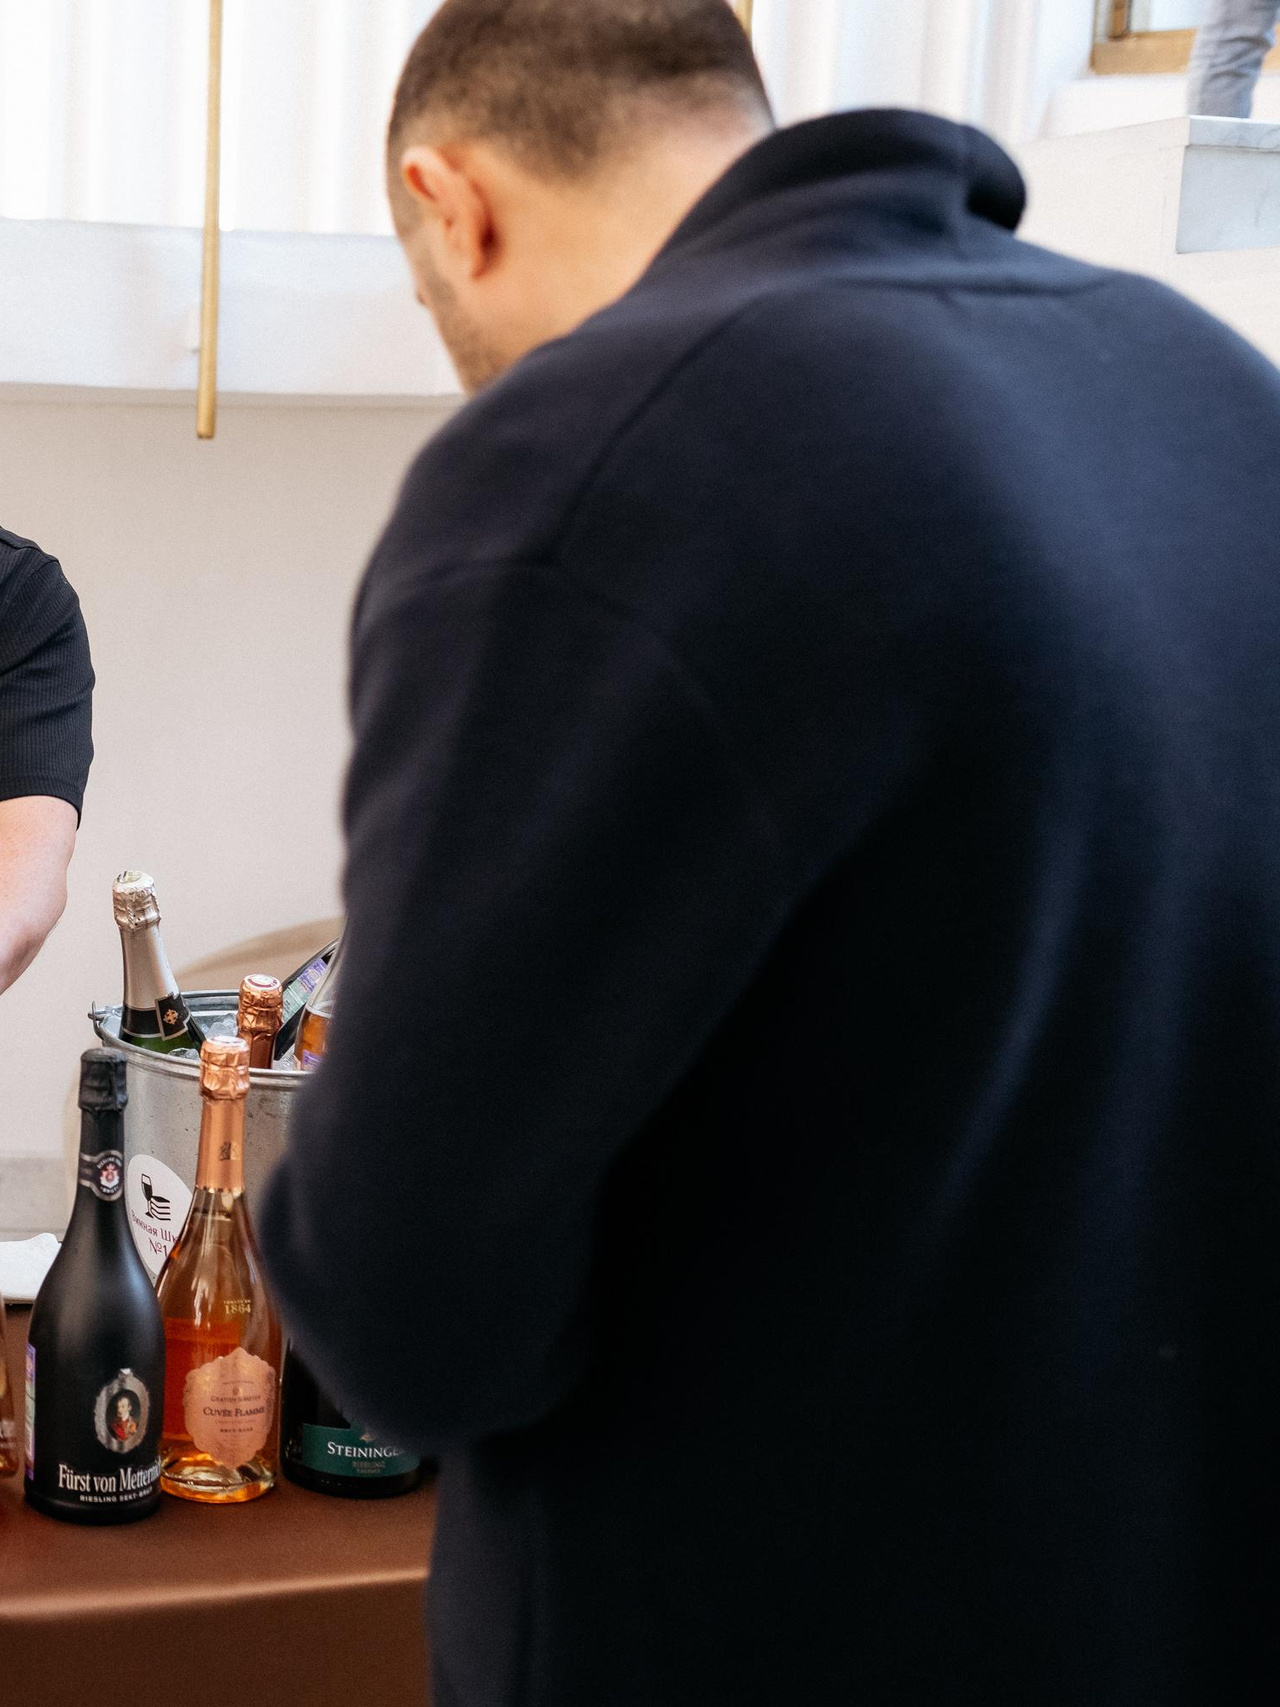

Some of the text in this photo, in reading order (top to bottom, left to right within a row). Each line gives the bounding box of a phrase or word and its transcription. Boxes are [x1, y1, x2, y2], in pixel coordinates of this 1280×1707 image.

[58, 1462, 92, 1493] Fürst
[92, 1475, 117, 1494] von
[79, 1494, 118, 1503] RIESLING
